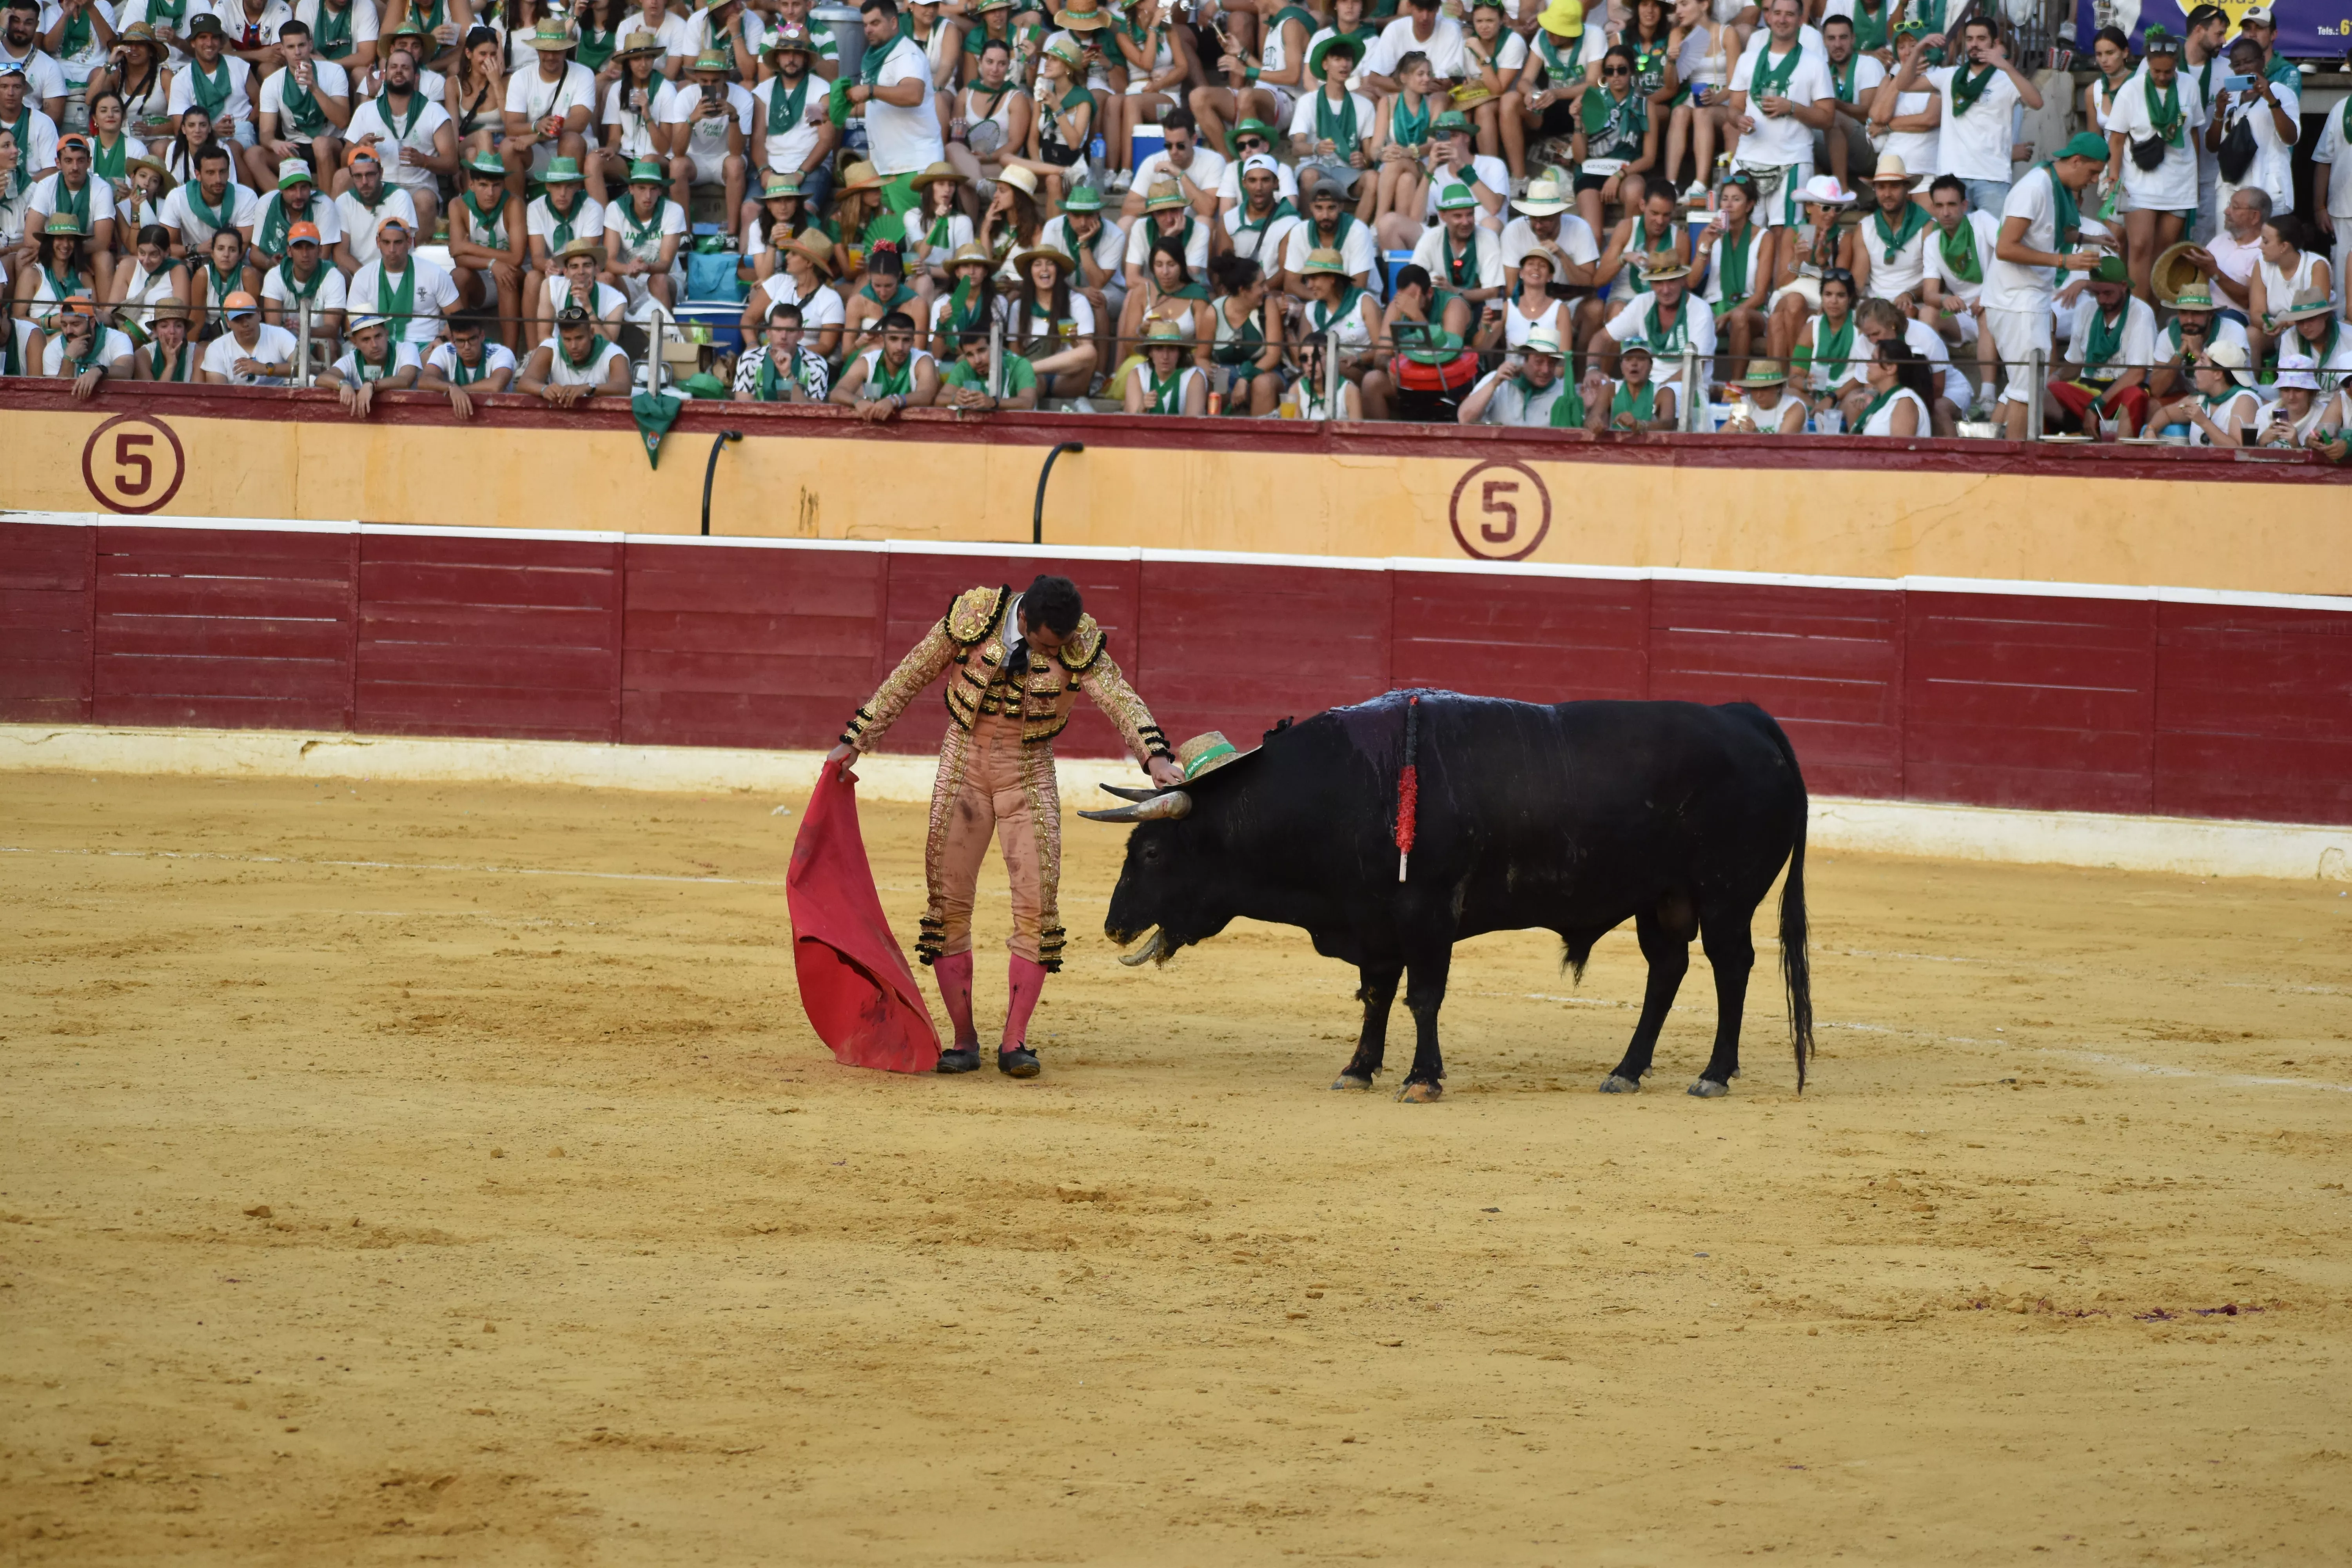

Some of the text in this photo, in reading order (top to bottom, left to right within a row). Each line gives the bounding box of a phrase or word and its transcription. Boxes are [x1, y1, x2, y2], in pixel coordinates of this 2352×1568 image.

[2340, 19, 2352, 36] 6
[115, 434, 153, 495] 5
[1481, 481, 1519, 543] 5
